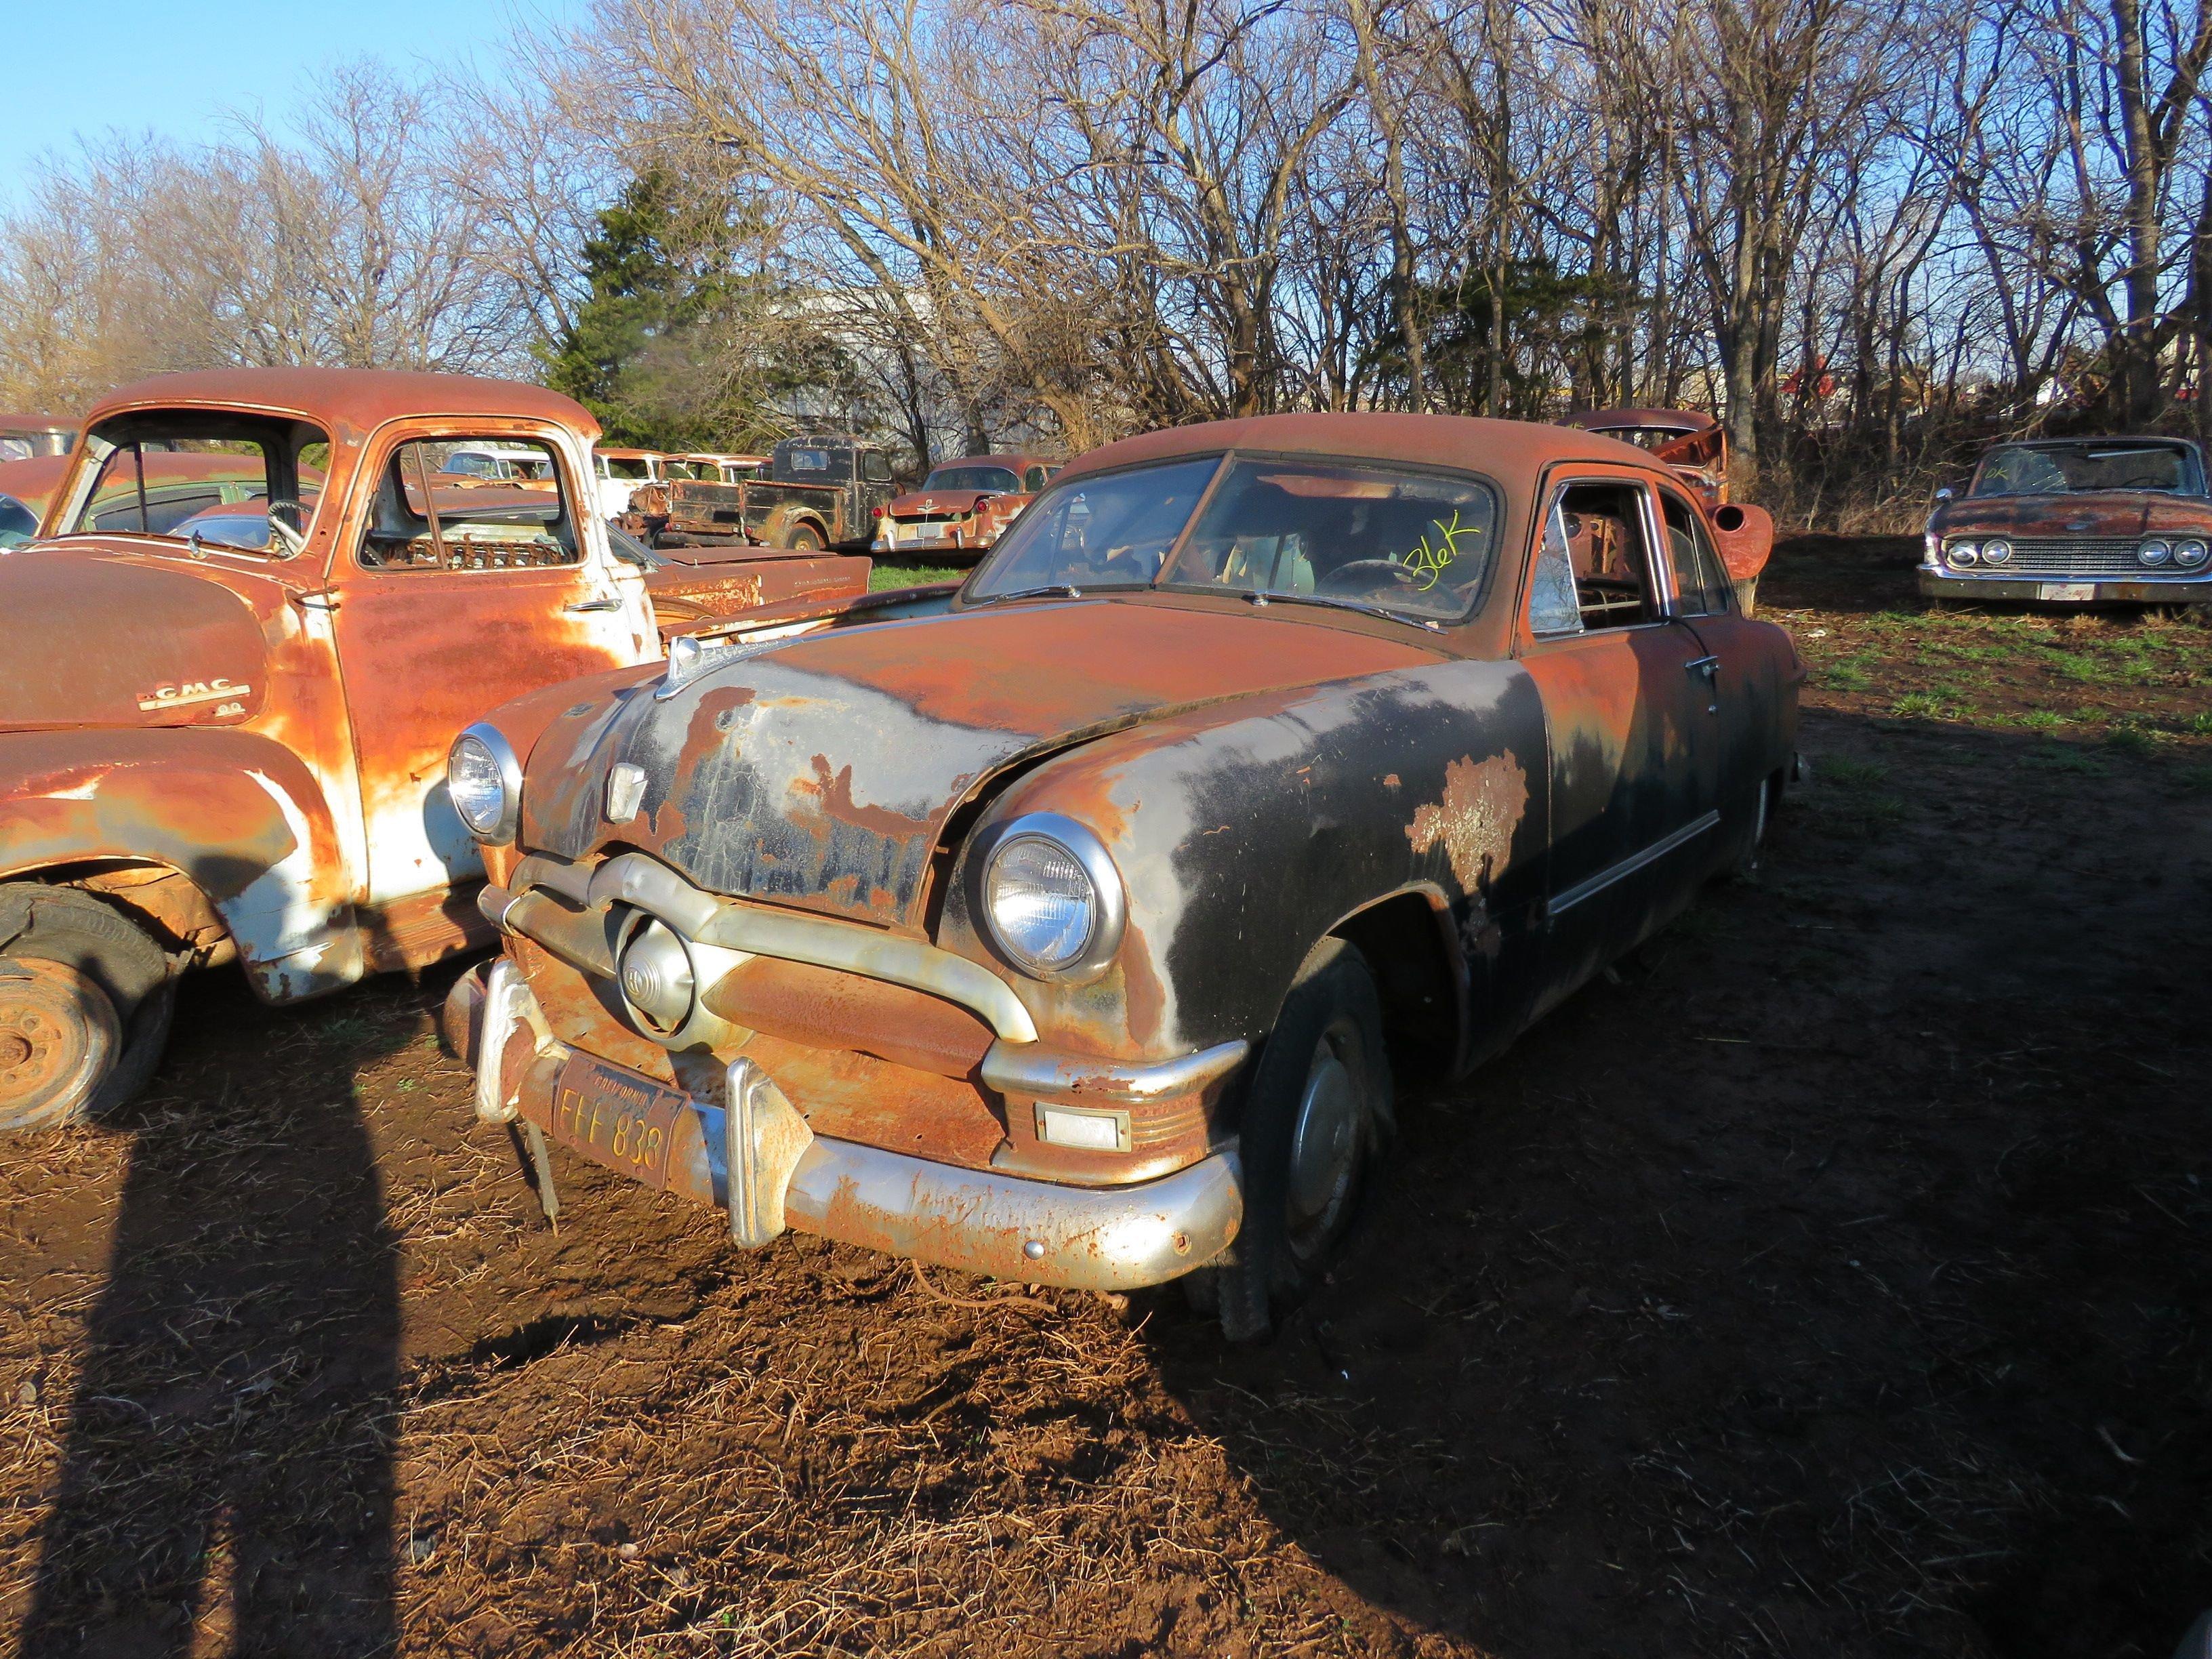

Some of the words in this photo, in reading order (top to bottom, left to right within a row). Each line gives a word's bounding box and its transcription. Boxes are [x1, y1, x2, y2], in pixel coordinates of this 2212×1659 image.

[155, 678, 231, 699] GMC
[594, 1075, 649, 1106] CALIFORNIA
[612, 1113, 663, 1170] 838
